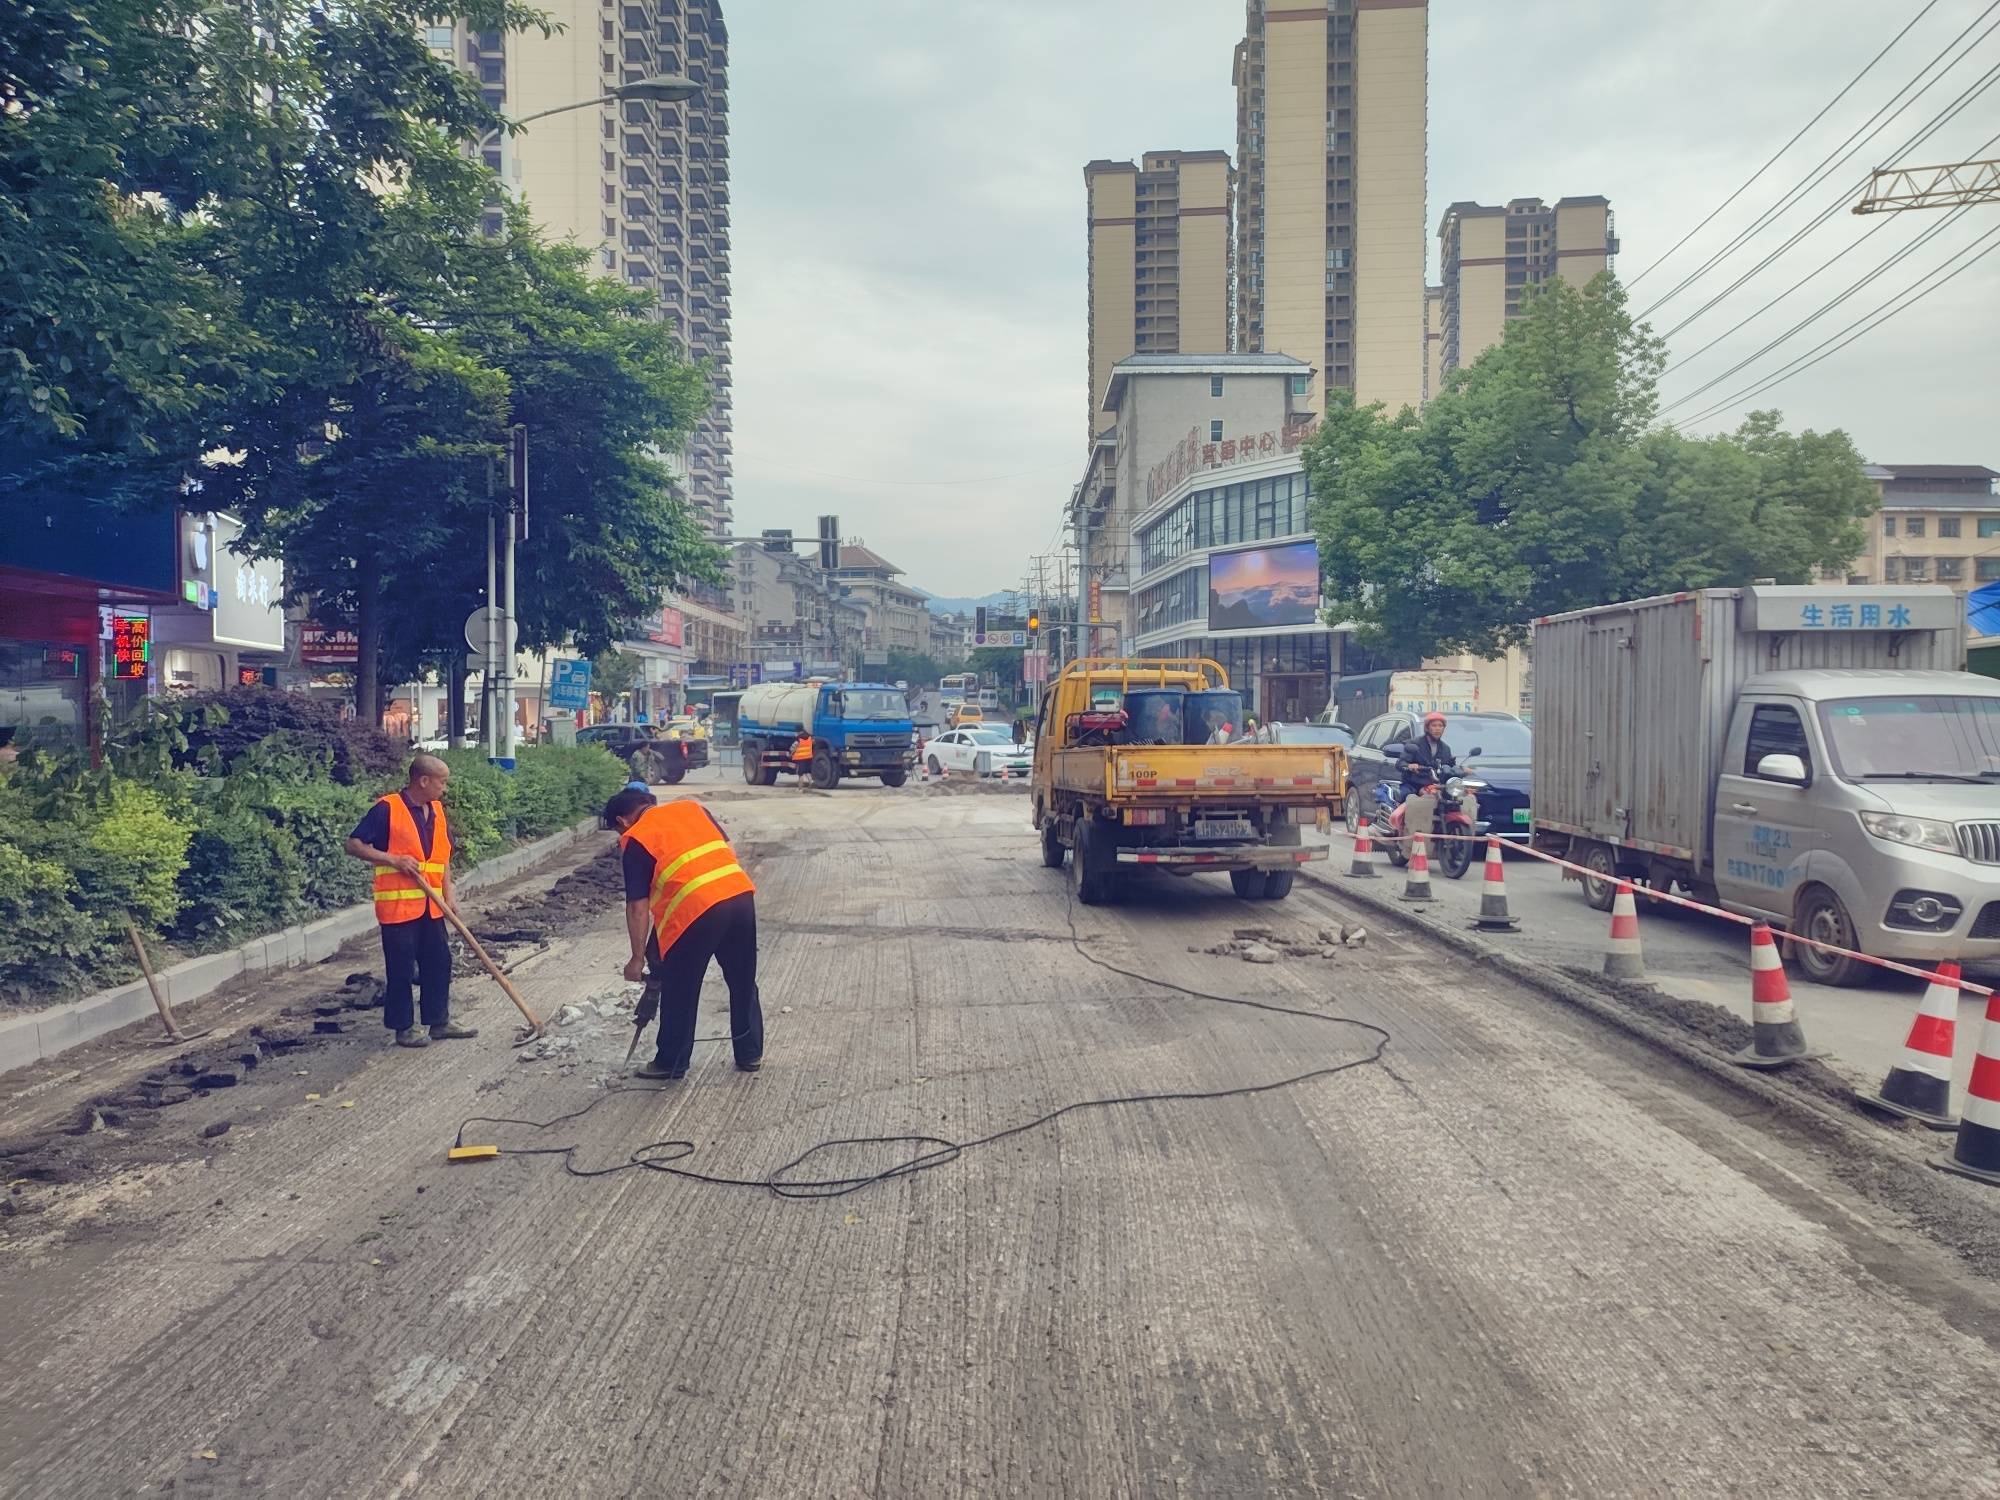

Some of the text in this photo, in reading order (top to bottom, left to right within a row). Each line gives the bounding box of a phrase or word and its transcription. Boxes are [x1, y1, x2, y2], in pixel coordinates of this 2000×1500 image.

[1202, 432, 1275, 464] 营销中心
[1799, 603, 1911, 628] 生活用水
[130, 621, 146, 677] 高价回收
[555, 660, 572, 682] P
[1130, 770, 1158, 779] 100P
